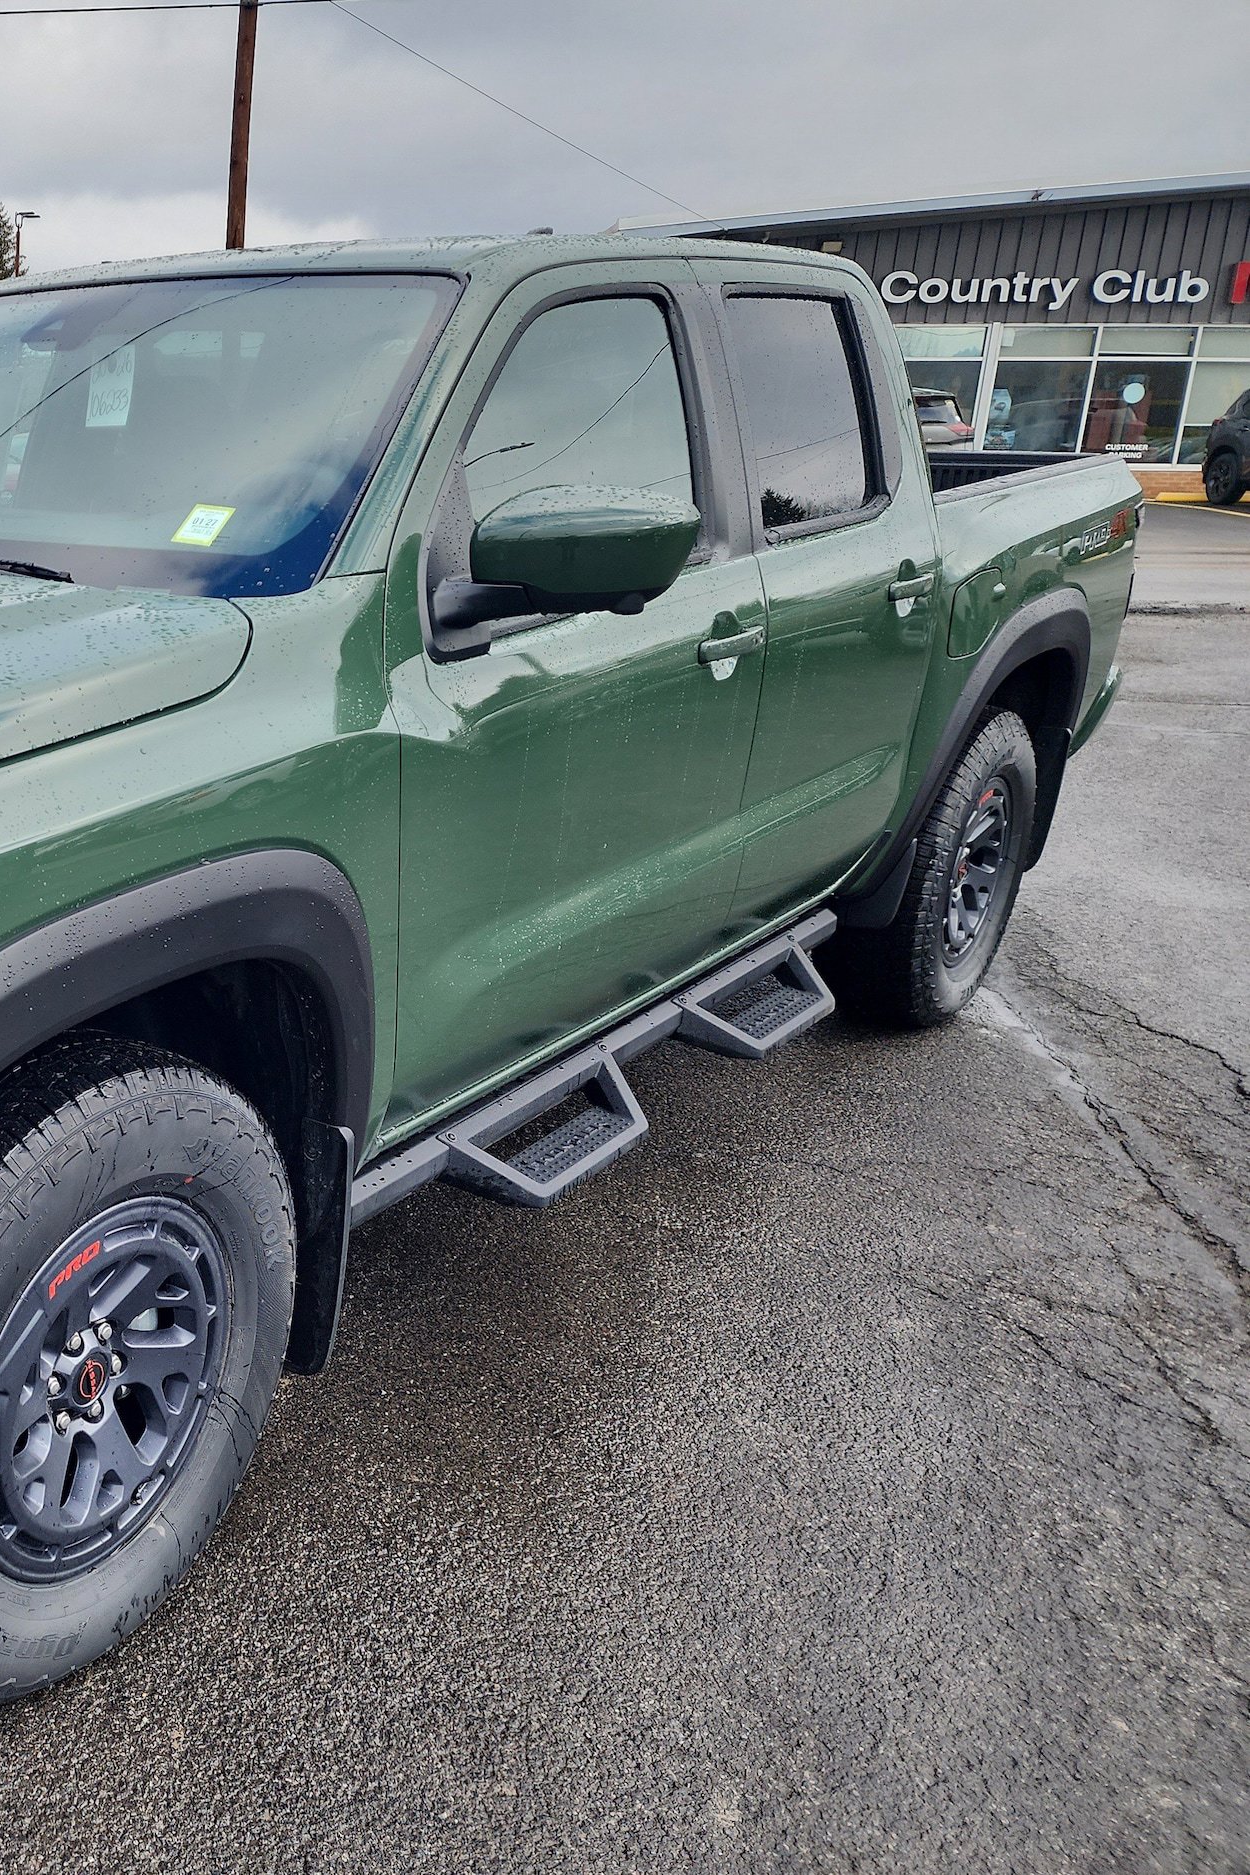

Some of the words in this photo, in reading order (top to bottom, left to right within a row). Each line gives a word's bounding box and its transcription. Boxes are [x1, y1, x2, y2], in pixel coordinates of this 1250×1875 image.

[881, 270, 1079, 310] Country
[1093, 269, 1210, 304] Club
[1105, 443, 1149, 451] CUSTOMER
[48, 1240, 100, 1300] PRO
